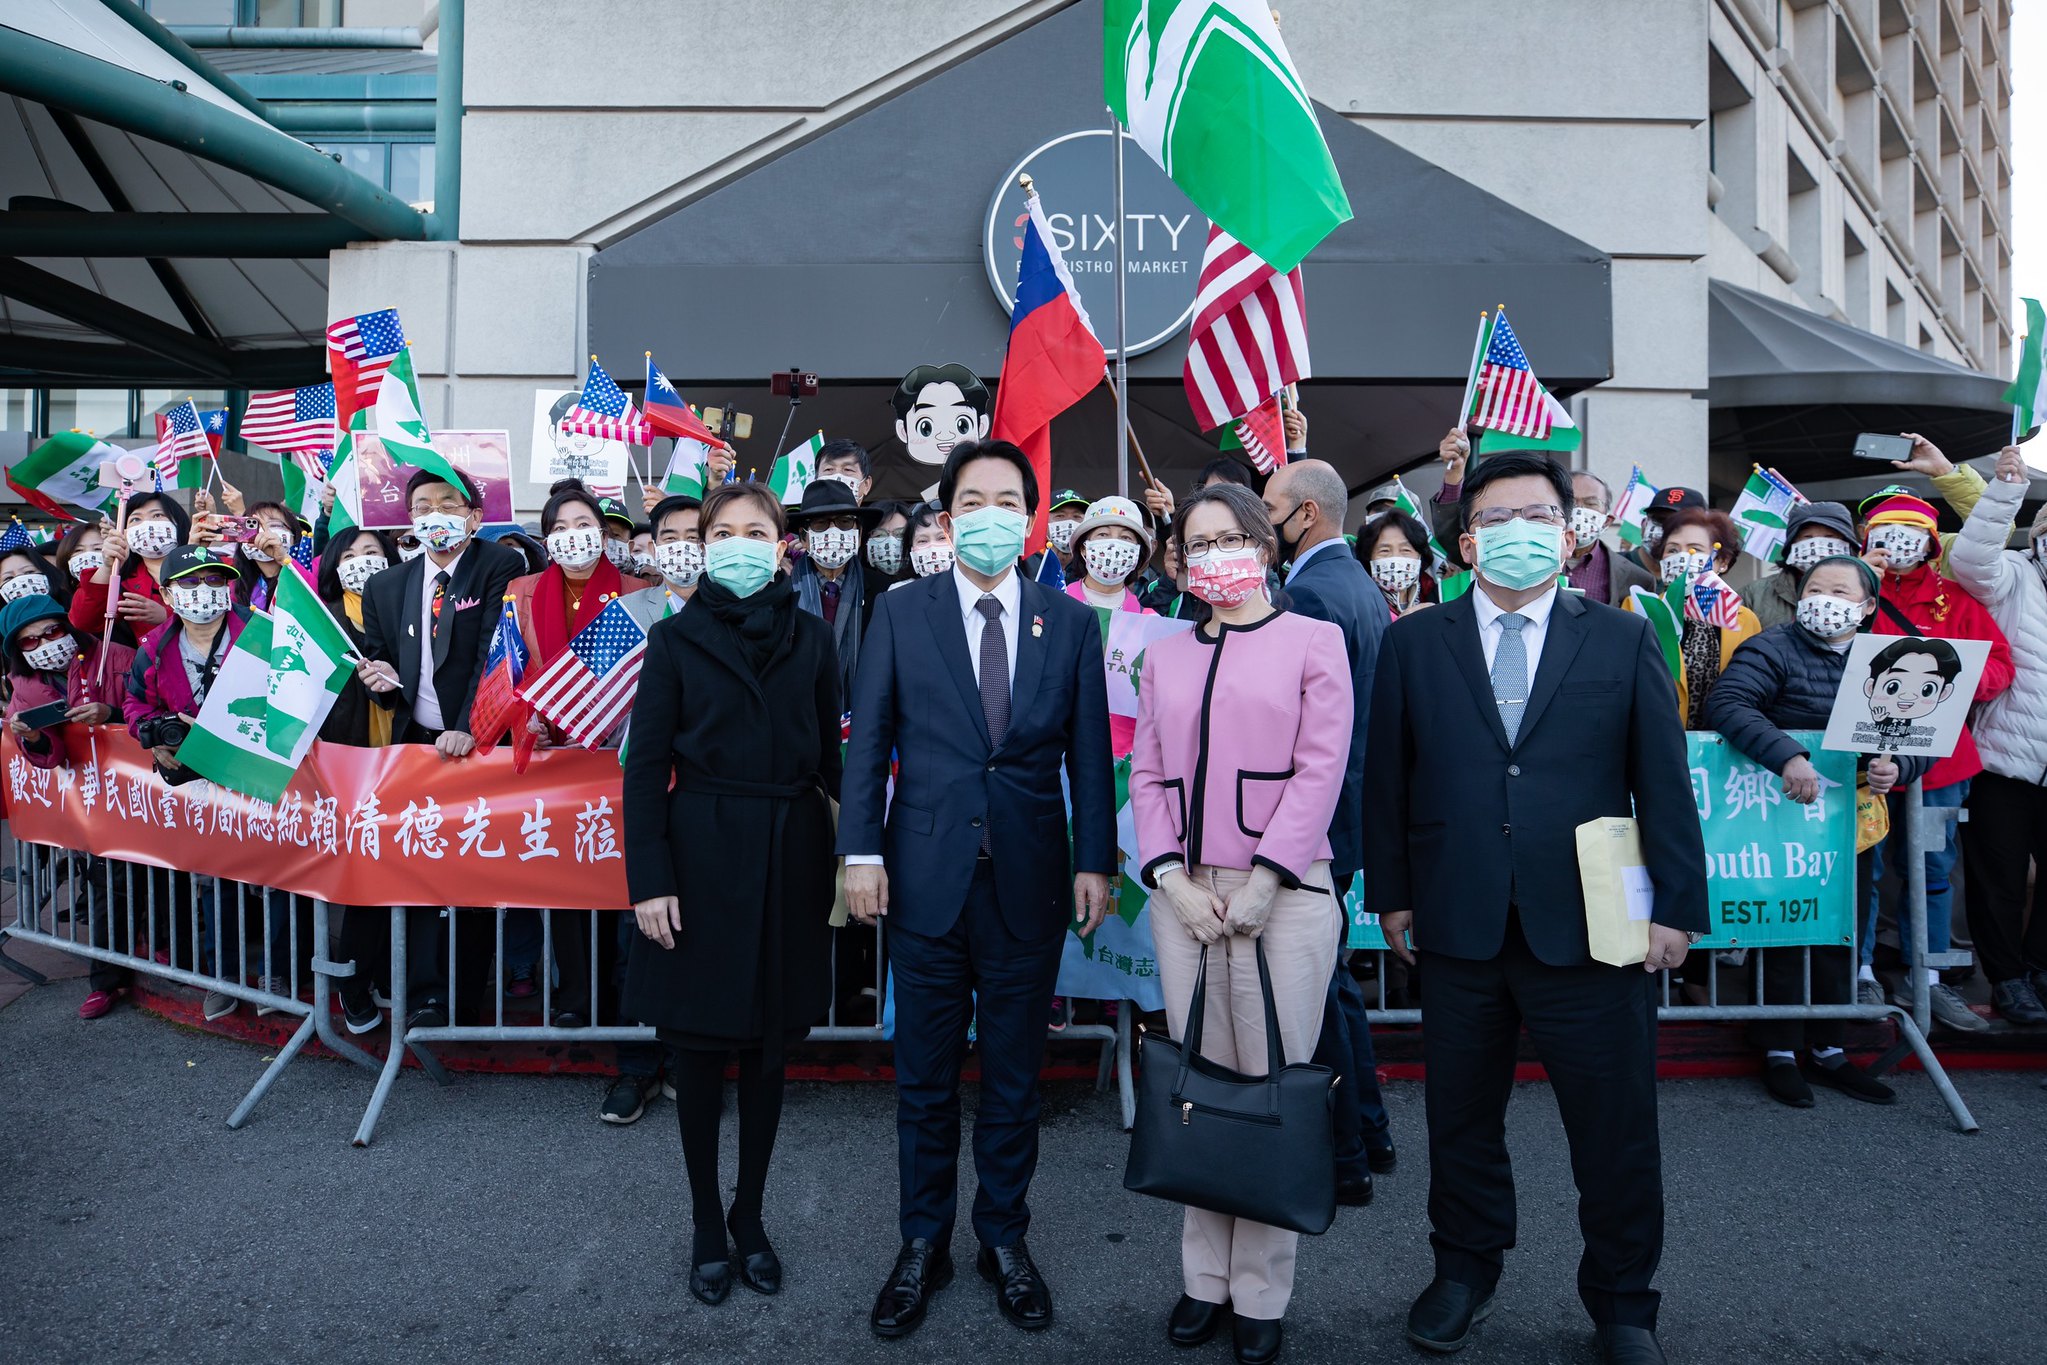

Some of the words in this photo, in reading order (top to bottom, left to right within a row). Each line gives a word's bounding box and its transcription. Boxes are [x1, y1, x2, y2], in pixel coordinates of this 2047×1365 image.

[1128, 261, 1189, 273] MARKET
[1705, 842, 1773, 879] outh
[1782, 842, 1838, 886] Bay
[1721, 901, 1770, 924] EST.
[1779, 897, 1818, 923] 1971
